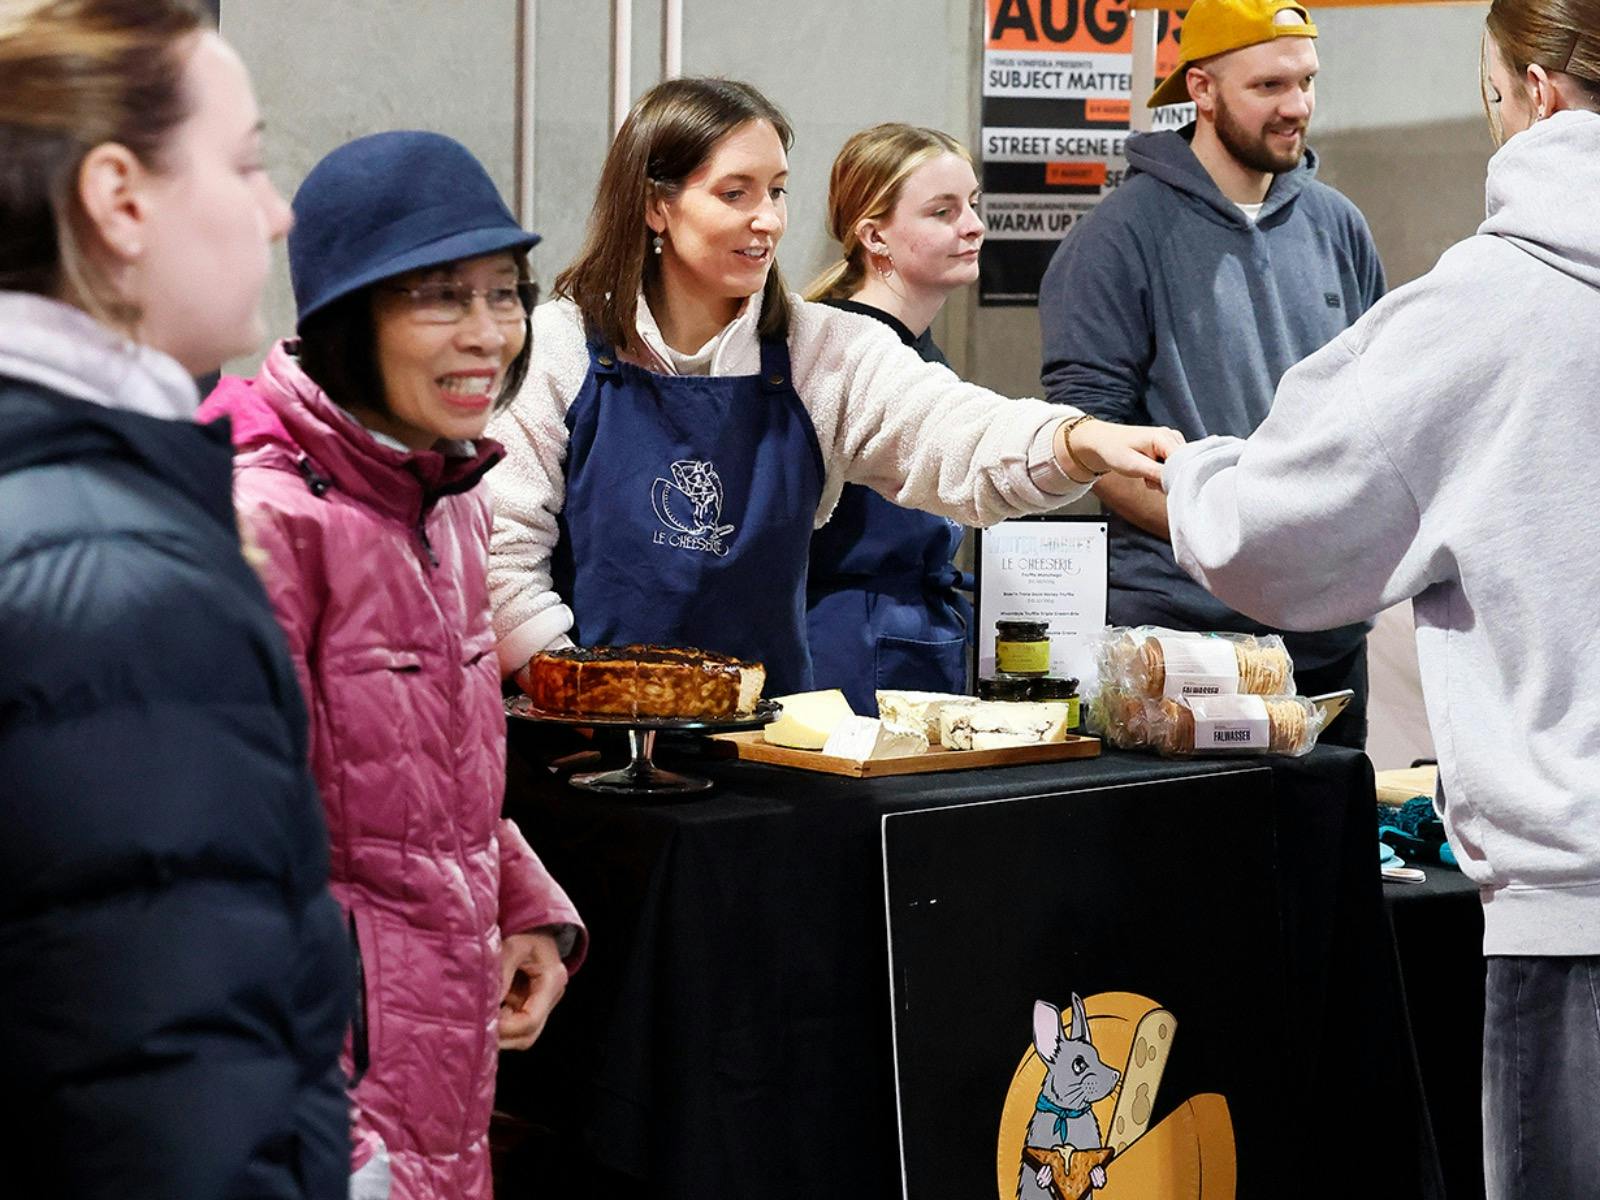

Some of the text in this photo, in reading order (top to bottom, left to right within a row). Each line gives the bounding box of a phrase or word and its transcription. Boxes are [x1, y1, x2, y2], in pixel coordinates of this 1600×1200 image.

[991, 0, 1186, 44] AUG
[990, 70, 1063, 89] SUBJECT
[989, 136, 1124, 156] STREET SCENE E
[986, 213, 1072, 231] WARM UP
[653, 530, 667, 545] LE
[1002, 558, 1013, 570] LE
[1213, 730, 1251, 742] FALWASSER
